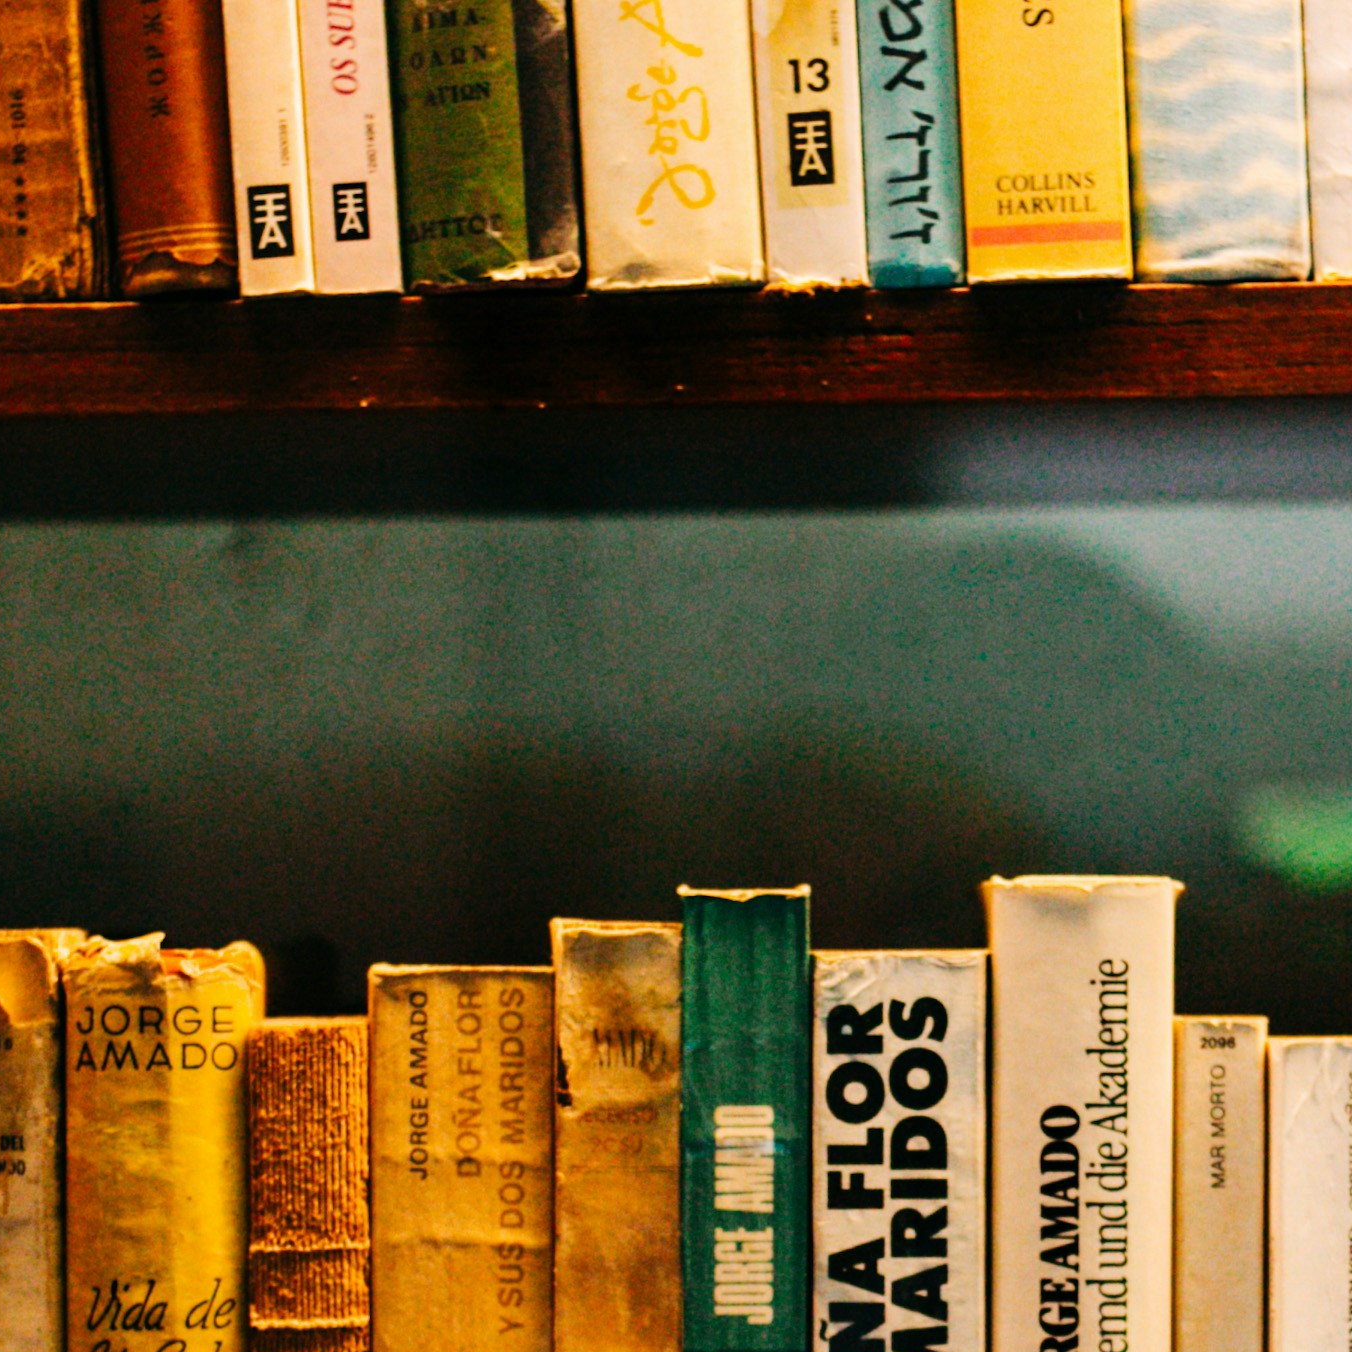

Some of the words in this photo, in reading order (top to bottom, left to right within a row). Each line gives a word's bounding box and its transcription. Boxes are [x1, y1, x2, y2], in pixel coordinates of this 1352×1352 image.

[144, 0, 171, 118] ЖОРЖ
[329, 58, 358, 96] OS
[787, 57, 830, 94] 13
[995, 172, 1097, 194] COLLINS
[995, 196, 1098, 216] HARVILL
[74, 1042, 239, 1072] AMADO
[75, 1004, 236, 1038] JORGE
[408, 990, 429, 1090] AMADO
[455, 989, 483, 1076] FLOR
[1085, 957, 1129, 1136] Akademie
[496, 987, 526, 1145] MARIDOS
[1210, 1064, 1226, 1136] MORTO
[409, 1096, 429, 1180] JORGE
[451, 1084, 483, 1179] DOÑA
[825, 1001, 888, 1211] FLOR
[0, 1134, 27, 1152] DEL
[714, 1104, 775, 1214] AMADO
[1085, 1144, 1128, 1192] die
[1210, 1143, 1226, 1190] MAR
[497, 1160, 526, 1234] DOS
[1039, 1103, 1081, 1273] AMADO
[498, 1240, 525, 1302] SUS
[1085, 1199, 1128, 1273] und
[84, 1279, 167, 1333] Vida
[184, 1278, 238, 1330] de
[714, 1226, 775, 1326] JORGE
[498, 1306, 524, 1337] Y
